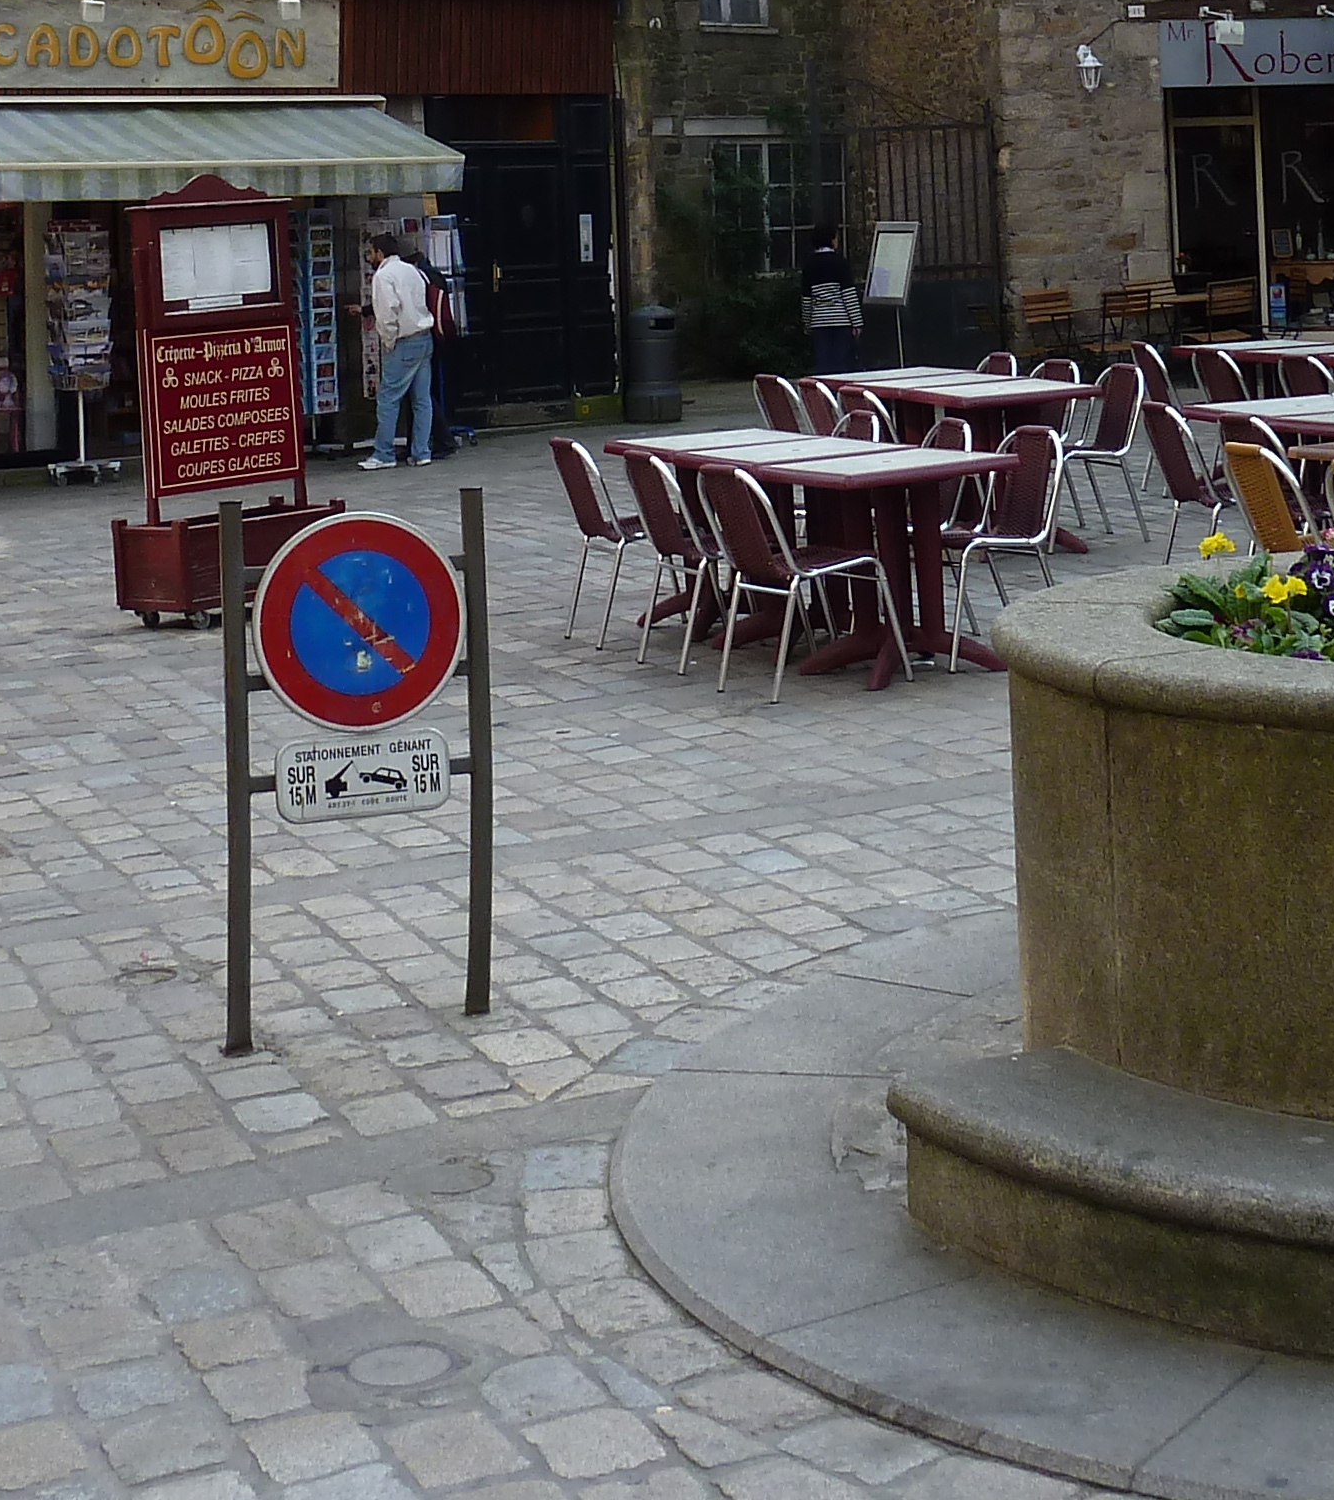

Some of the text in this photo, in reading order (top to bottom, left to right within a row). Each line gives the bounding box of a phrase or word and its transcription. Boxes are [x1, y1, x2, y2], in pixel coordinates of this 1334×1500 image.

[1168, 22, 1196, 42] Mr.
[244, 336, 286, 353] d'Armor
[184, 370, 223, 387] SNACK
[231, 366, 263, 382] PIZZA
[180, 387, 270, 410] MOULES FRITES
[163, 406, 290, 435] SALADES COMPOSEES
[171, 436, 229, 456] GALETTES
[238, 429, 285, 448] CREPES
[178, 452, 281, 478] COUPES GLACEES
[295, 745, 381, 763] STATIONNEMENT
[412, 753, 439, 772] SUR
[287, 766, 315, 785] SUR
[414, 772, 441, 794] 15 M
[289, 785, 316, 806] 15 M
